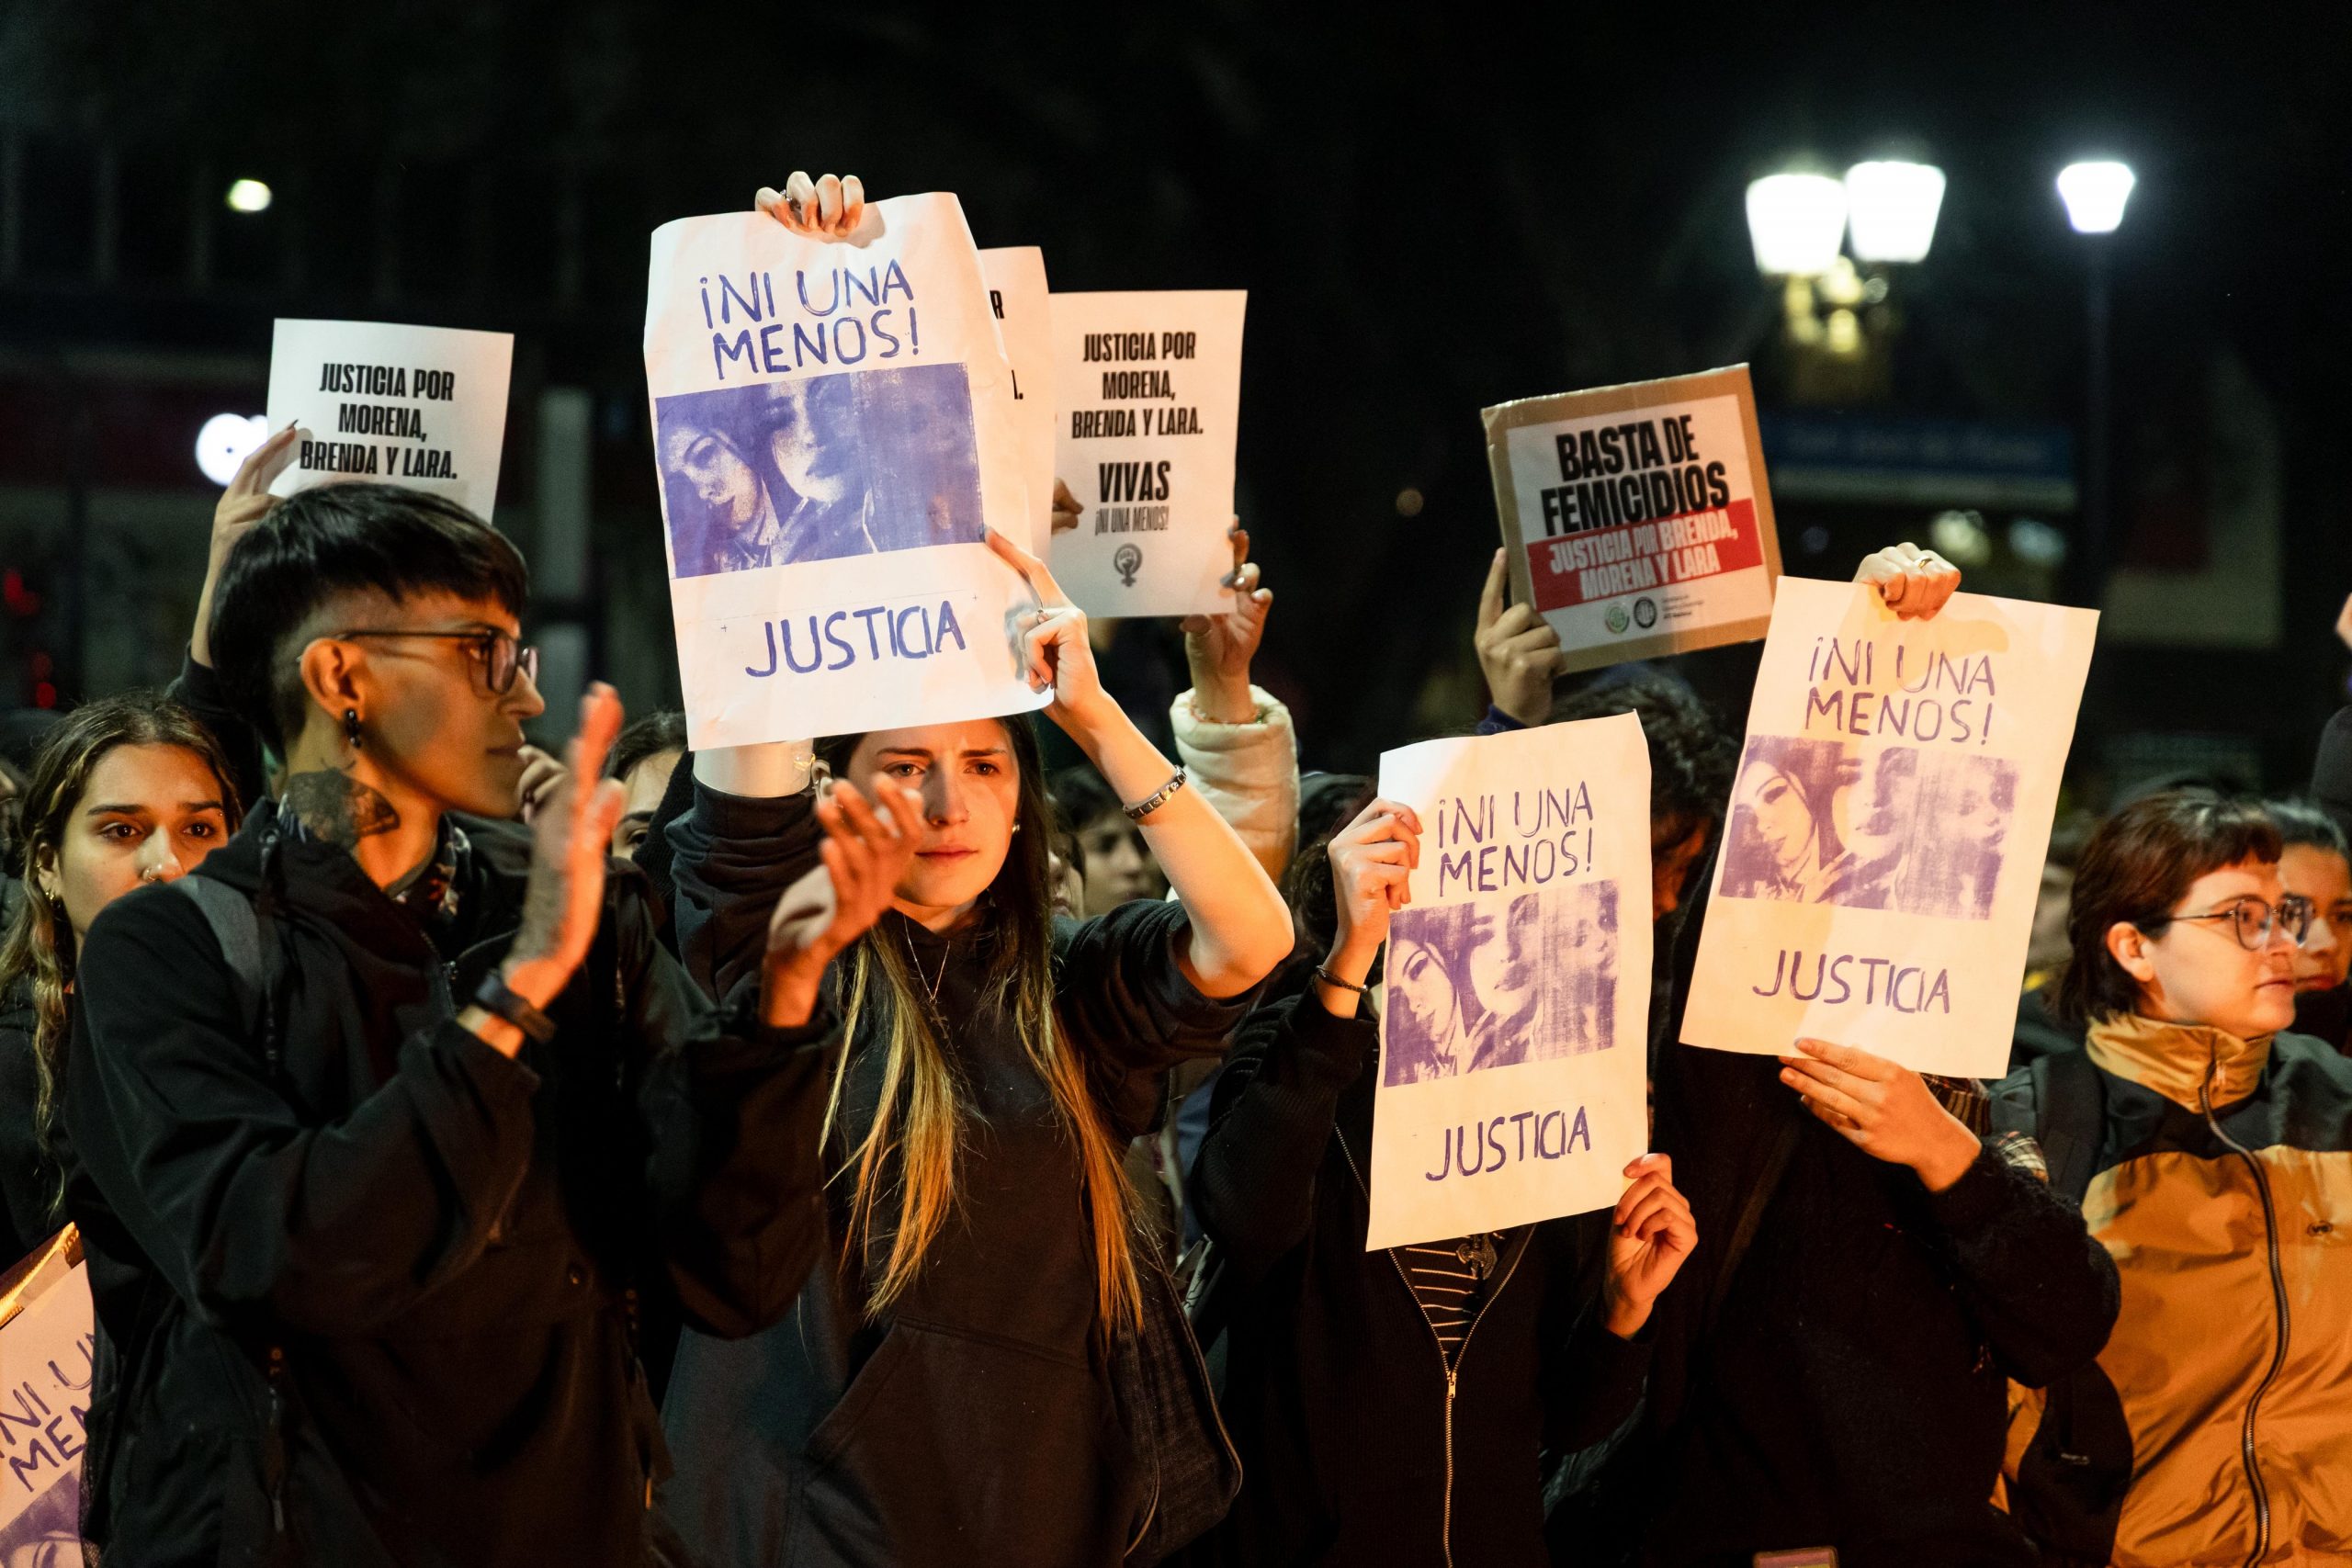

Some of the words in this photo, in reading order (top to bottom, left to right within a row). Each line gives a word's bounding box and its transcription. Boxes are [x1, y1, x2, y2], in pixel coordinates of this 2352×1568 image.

[699, 271, 775, 329] ¡NI
[797, 258, 914, 317] UNA
[712, 307, 920, 380] MENOS!
[1083, 333, 1156, 362] JUSTICIA
[1162, 332, 1196, 360] POR
[319, 363, 406, 397] JUSTICIA
[413, 368, 455, 400] POR
[1102, 370, 1175, 401] MORENA,
[338, 403, 427, 442] MORENA,
[1072, 409, 1136, 439] BRENDA
[1143, 409, 1153, 436] Y
[1158, 407, 1204, 435] LARA.
[1555, 419, 1664, 481] BASTA
[1662, 414, 1699, 464] DE
[300, 440, 378, 474] BRENDA
[386, 446, 399, 475] Y
[402, 448, 458, 479] LARA.
[1099, 461, 1170, 503] VIVAS
[1111, 507, 1130, 532] UNA
[1541, 461, 1729, 536] FEMICIDIOS
[1549, 528, 1634, 574] JUSTICIA
[1633, 524, 1658, 556] POR
[1657, 509, 1738, 551] BRENDA,
[1579, 554, 1658, 601] MORENA
[1656, 553, 1669, 583] Y
[1671, 543, 1721, 581] LARA
[745, 600, 966, 677] JUSTICIA
[1809, 637, 1872, 686] ¡NI
[1896, 645, 1996, 696] UNA
[1805, 686, 1993, 745] MENOS!
[1439, 795, 1495, 849] ¡NI
[1514, 781, 1593, 838] UNA
[1439, 828, 1593, 897] MENOS!
[1752, 949, 1951, 1015] JUSTICIA
[1425, 1105, 1590, 1181] JUSTICIA
